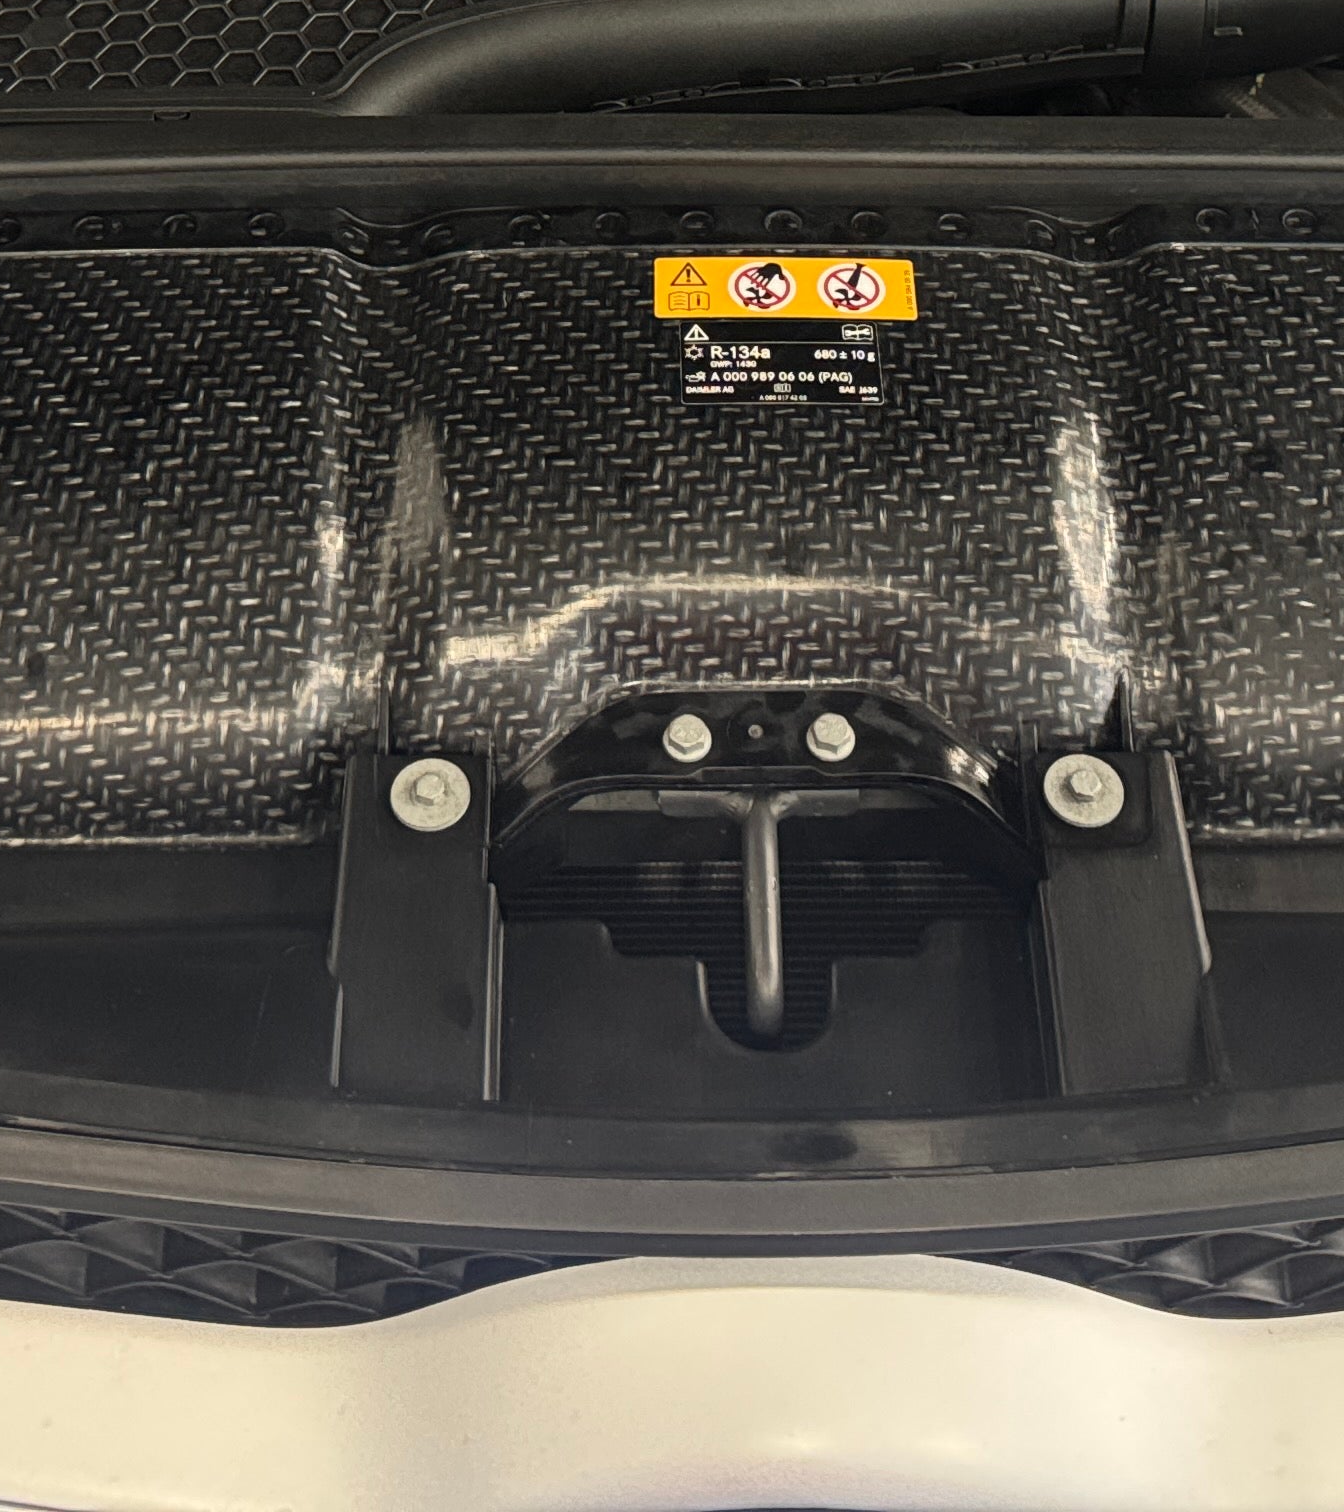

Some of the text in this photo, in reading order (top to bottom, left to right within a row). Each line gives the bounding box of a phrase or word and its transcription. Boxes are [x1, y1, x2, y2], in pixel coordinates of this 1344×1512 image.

[710, 345, 771, 360] R-134a
[814, 349, 837, 360] 680
[851, 349, 865, 360] 10
[867, 352, 875, 362] g
[710, 360, 757, 368] GWP: 1430
[710, 372, 853, 384] A 000 989 06 06 (PAG)
[722, 386, 734, 394] AG
[838, 386, 856, 394] SAE
